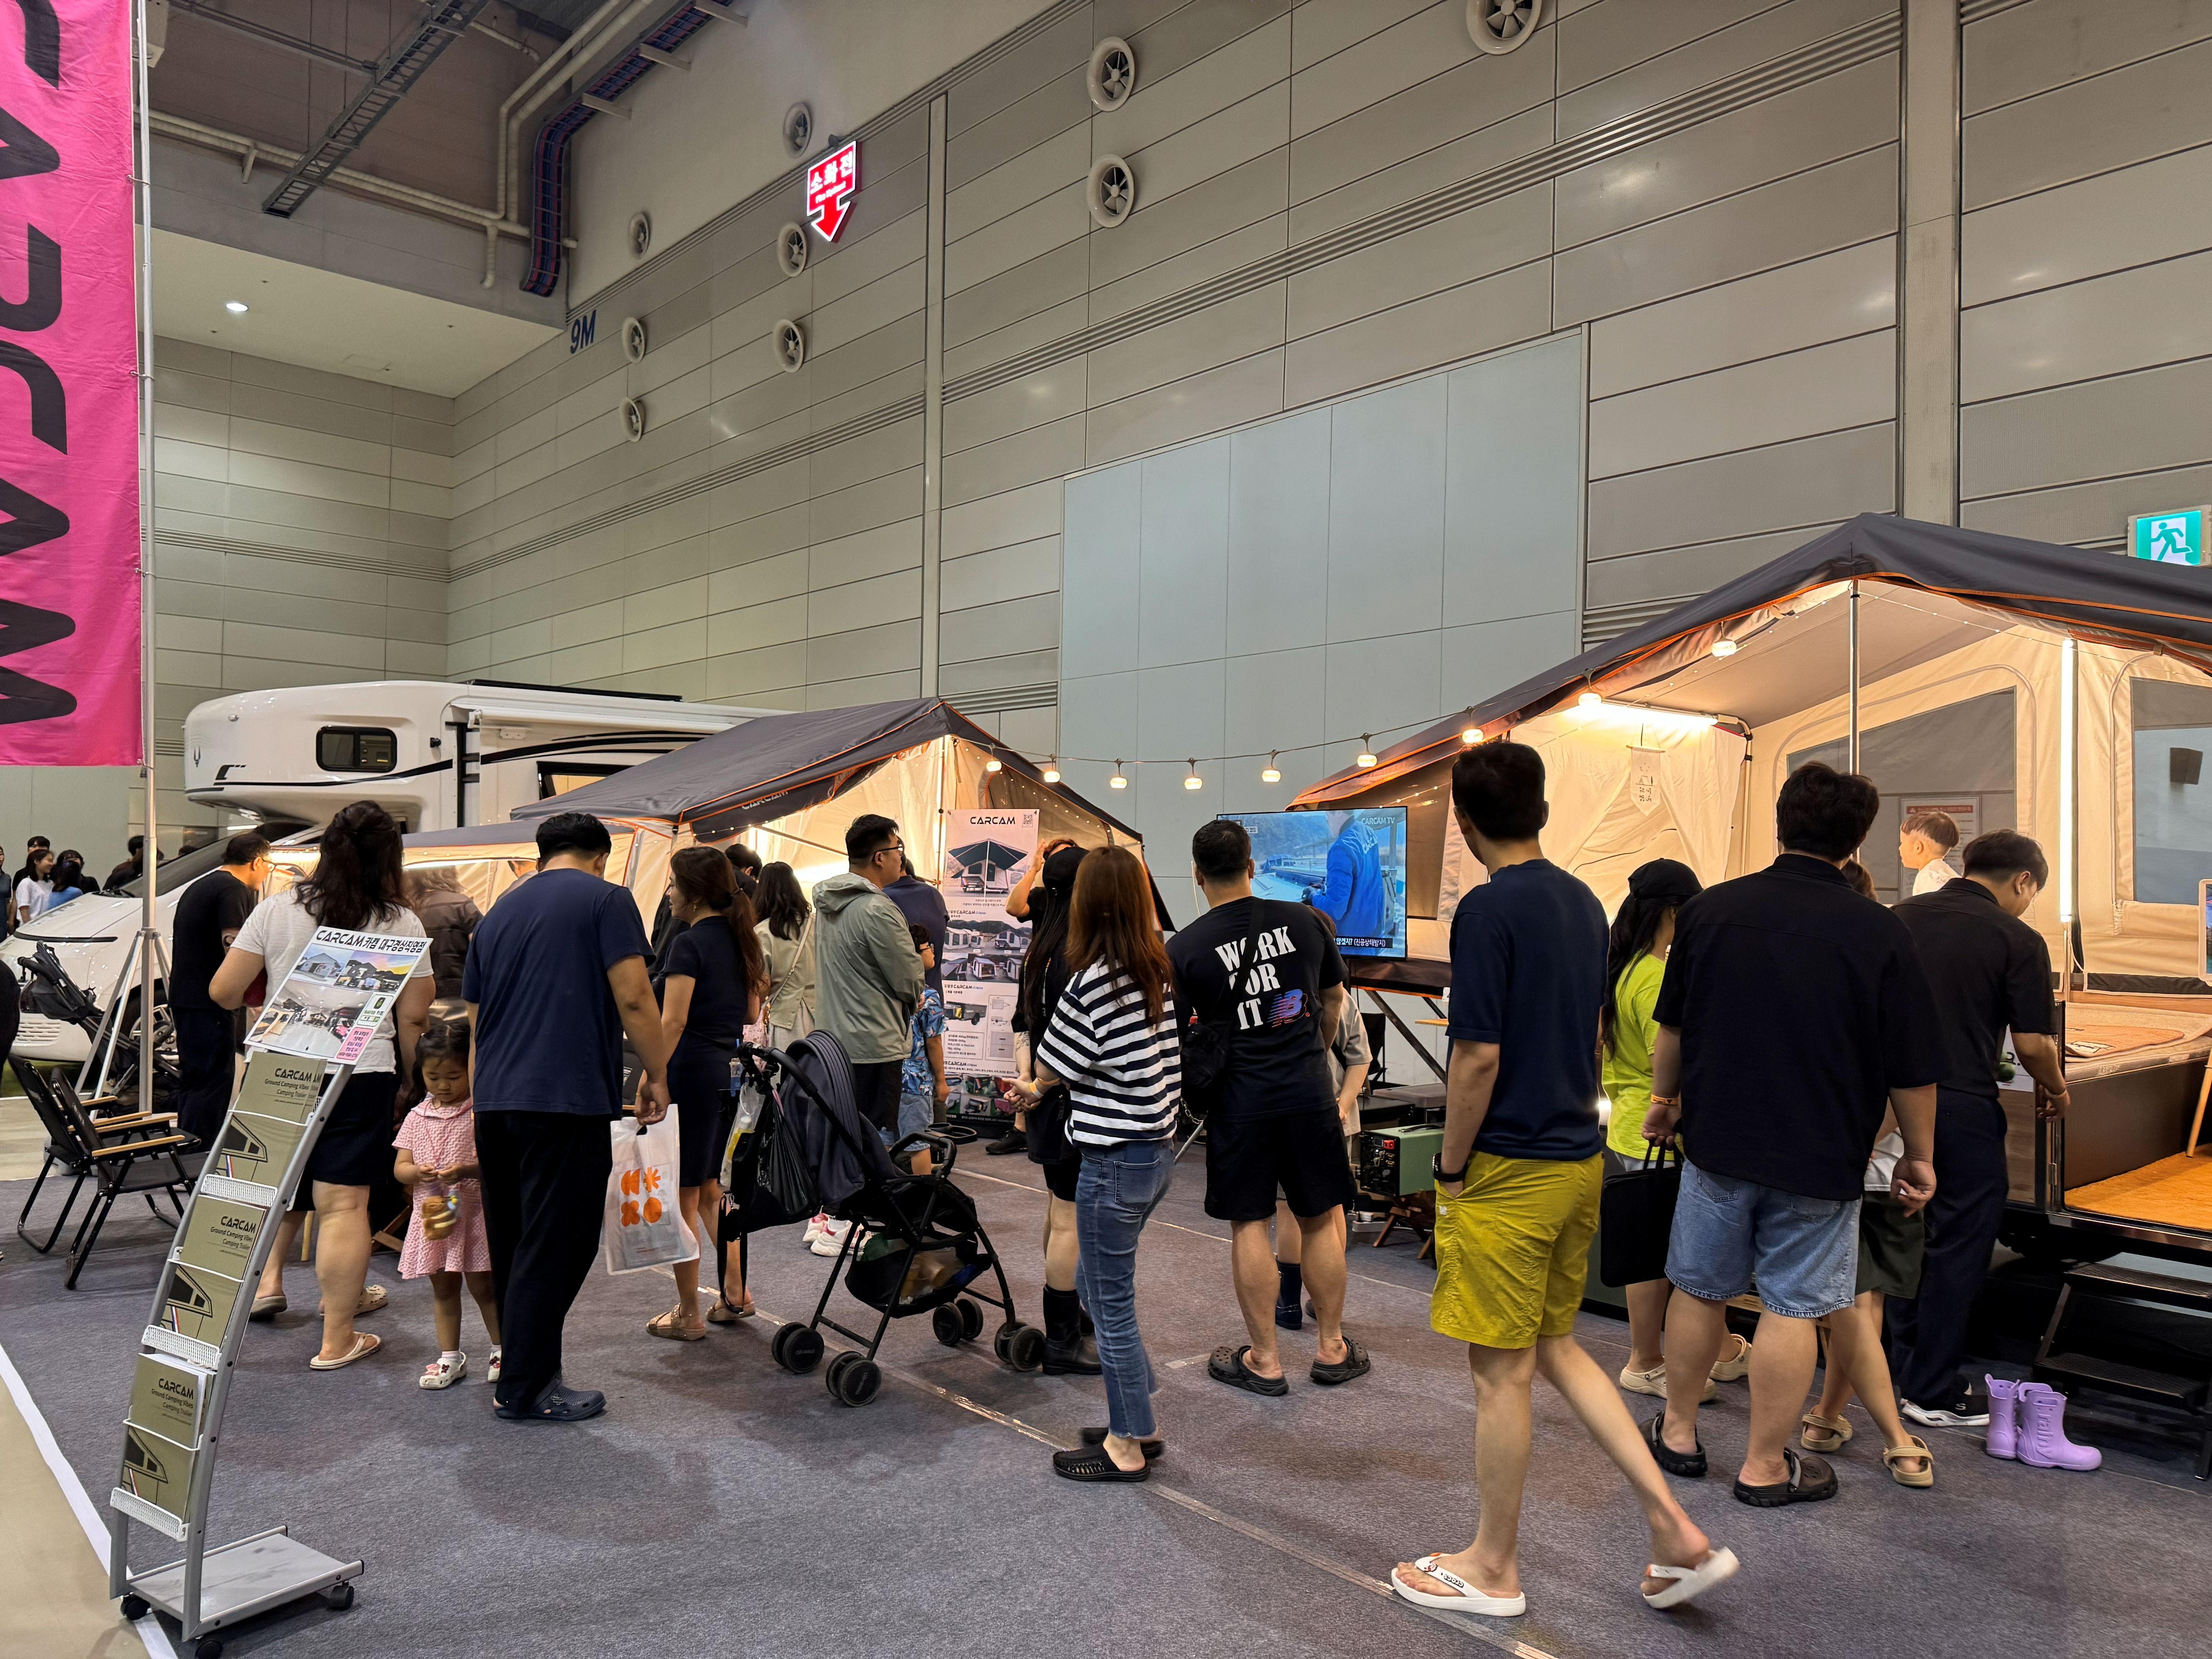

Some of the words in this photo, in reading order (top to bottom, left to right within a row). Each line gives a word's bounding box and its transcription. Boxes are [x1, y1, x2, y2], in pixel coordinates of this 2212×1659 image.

[570, 310, 596, 354] 9M
[970, 816, 1015, 824] CARCAM
[316, 930, 365, 947] CARCAM
[1215, 926, 1296, 972] WRK
[1237, 998, 1264, 1030] IT
[275, 1068, 312, 1082] CARCAM
[210, 1226, 227, 1235] Ground
[221, 1216, 256, 1233] CARCAM
[158, 1377, 193, 1400] CARCAM
[165, 1394, 182, 1406] Camping
